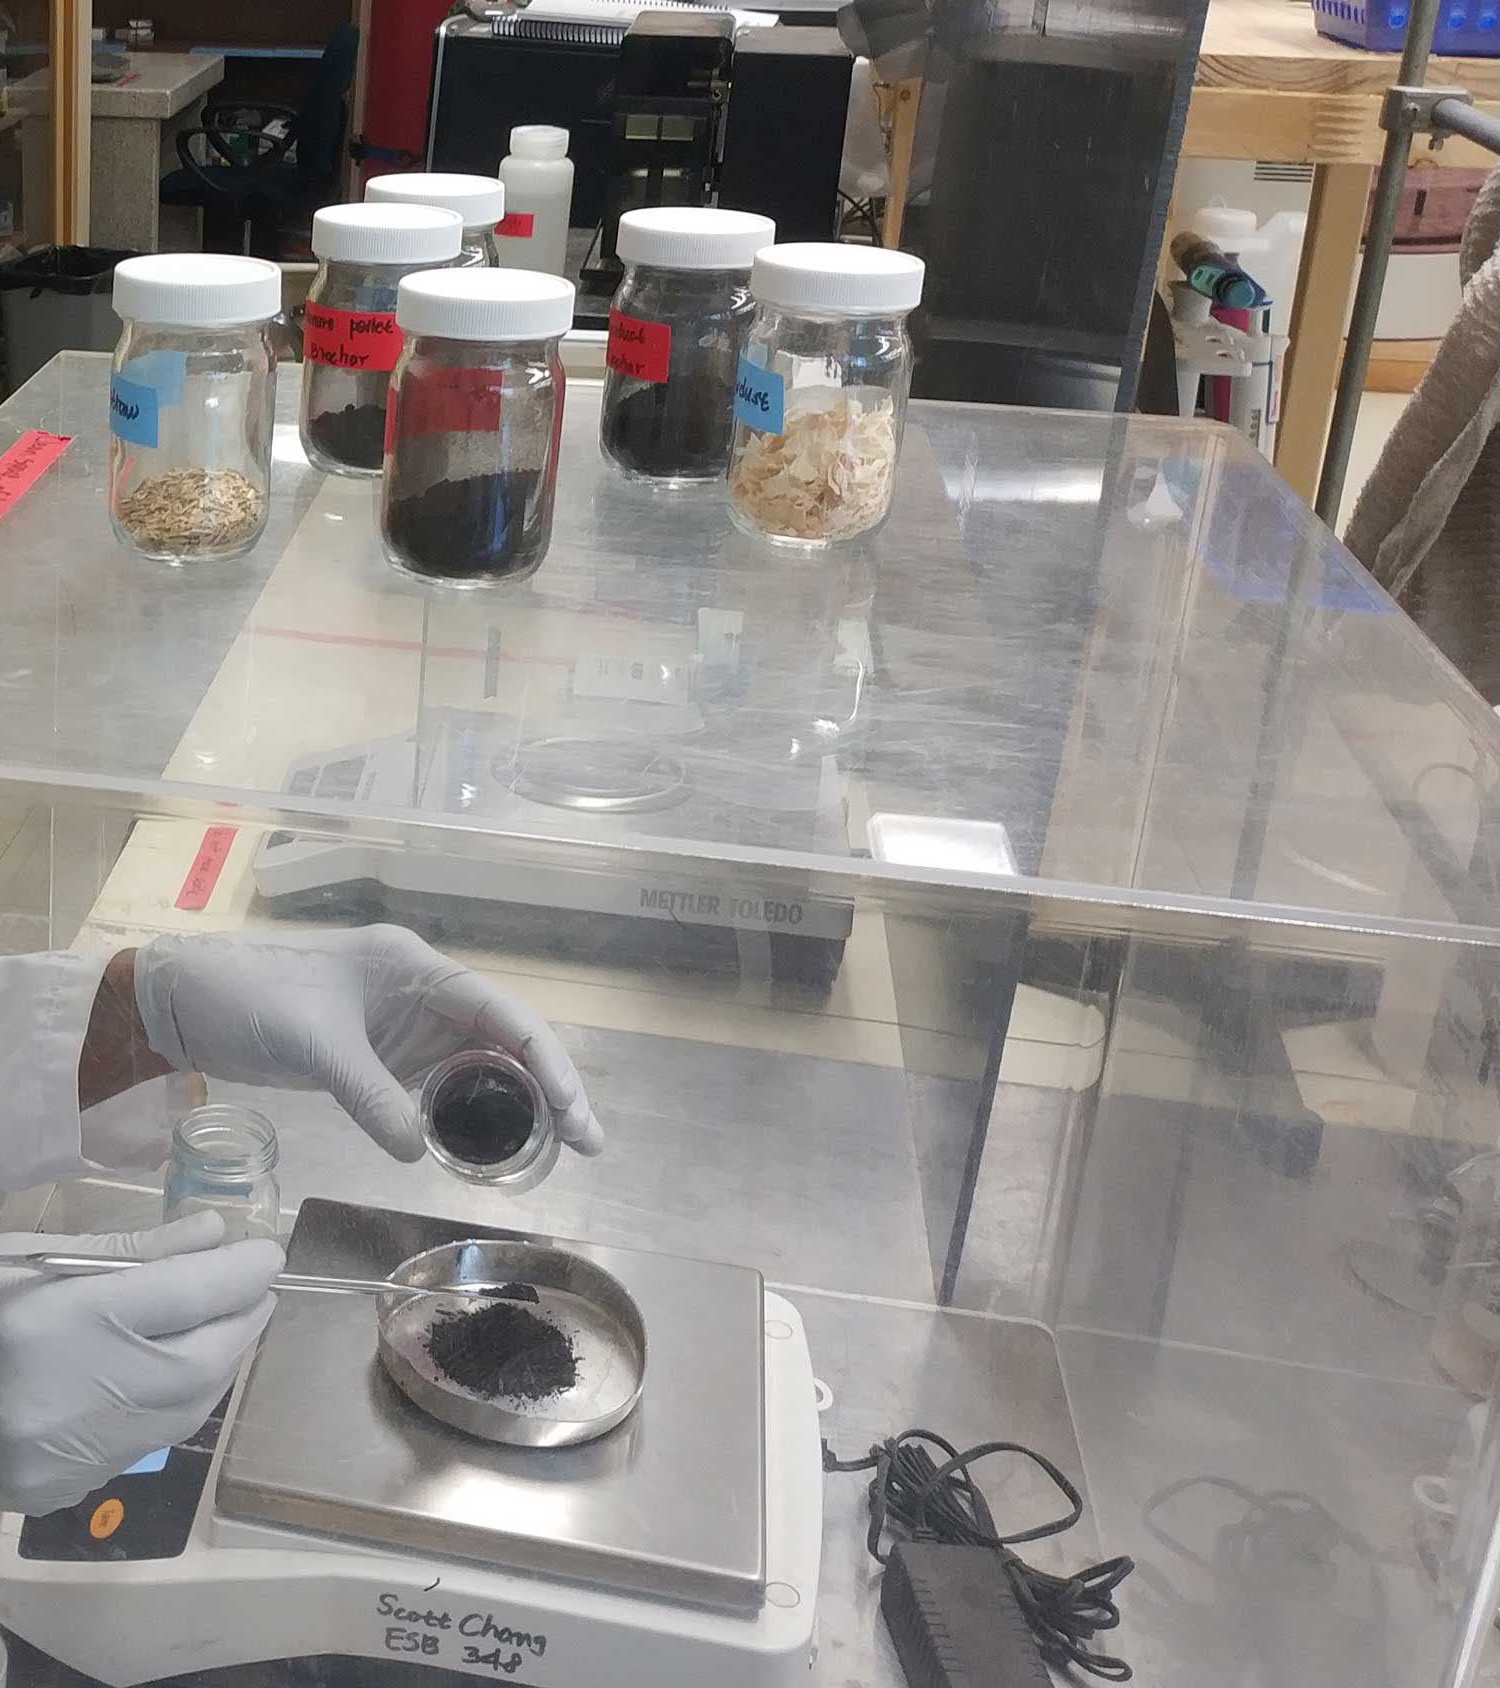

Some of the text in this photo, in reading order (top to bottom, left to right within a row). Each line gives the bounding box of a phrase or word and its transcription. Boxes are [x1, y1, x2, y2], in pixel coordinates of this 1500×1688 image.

[640, 887, 804, 926] METTLER TOLEDO
[376, 1592, 453, 1630] Scott
[385, 1626, 523, 1674] ESB 348
